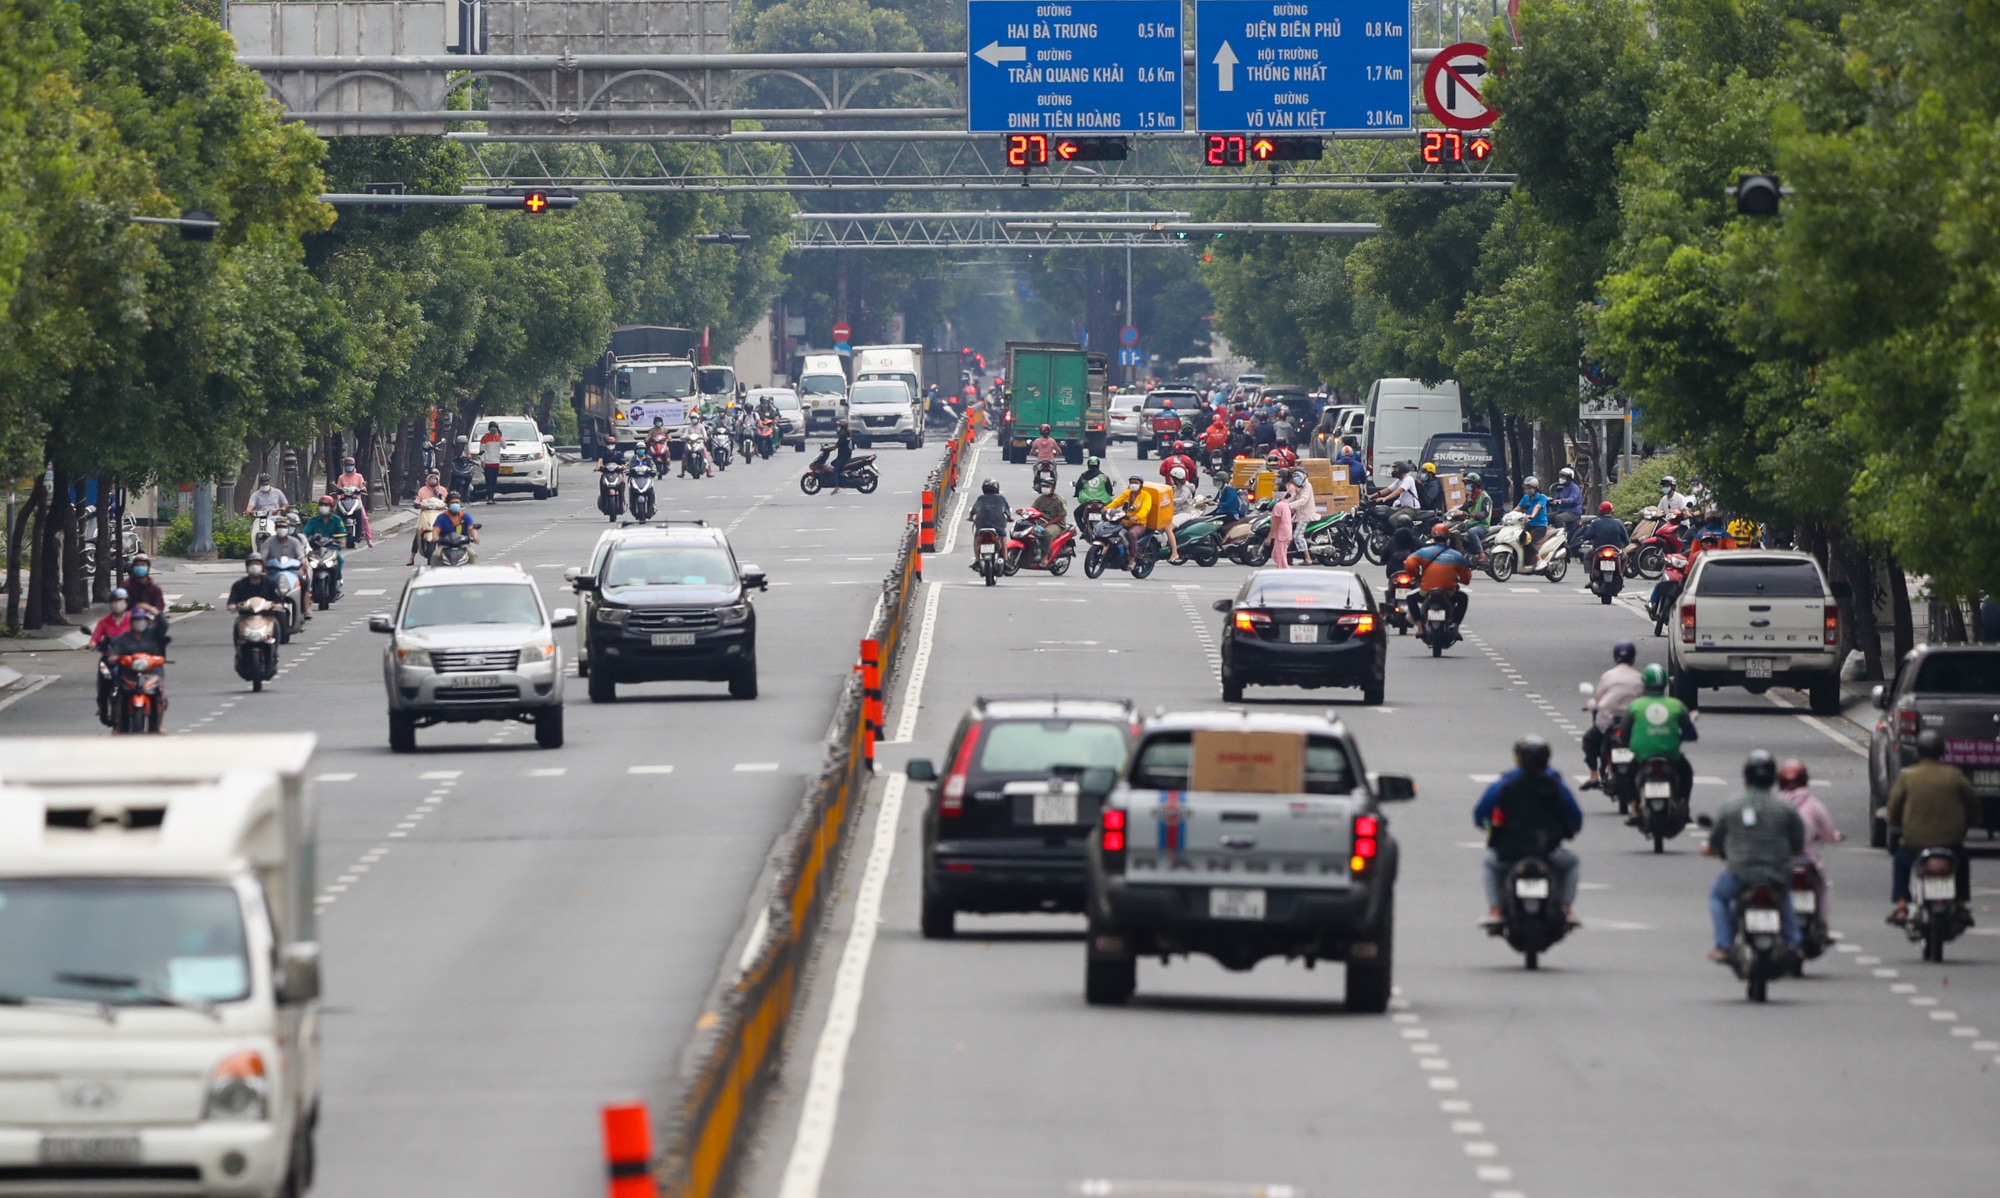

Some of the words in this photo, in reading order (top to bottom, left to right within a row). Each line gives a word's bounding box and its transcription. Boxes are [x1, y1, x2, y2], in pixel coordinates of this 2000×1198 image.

[1037, 3, 1072, 17] ĐƯỜNG
[1273, 2, 1308, 16] ĐƯỜNG
[1007, 23, 1029, 39] HAI
[1033, 20, 1051, 39] BÀ
[1054, 22, 1098, 39] TRƯNG
[1138, 23, 1154, 39] 0,5
[1157, 23, 1175, 38] Km
[1245, 20, 1276, 41] ĐIỆN
[1280, 19, 1311, 38] BIÊN
[1315, 18, 1341, 38] PHỦ
[1365, 22, 1381, 38] 0,8
[1385, 22, 1403, 37] Km
[1037, 47, 1072, 61] ĐƯỜNG
[1257, 47, 1275, 61] HỘI
[1277, 46, 1319, 60] TRƯỜNG
[1008, 62, 1042, 83] TRẦN
[1045, 68, 1089, 83] QUANG
[1093, 63, 1124, 83] KHẢI
[1138, 68, 1154, 83] 0,6
[1157, 68, 1175, 82] Km
[1246, 61, 1290, 82] THỐNG
[1294, 61, 1327, 81] NHẤT
[1366, 66, 1382, 82] 1,7
[1385, 66, 1403, 80] Km
[1037, 92, 1072, 106] ĐƯỜNG
[1274, 91, 1309, 105] ĐƯỜNG
[1007, 112, 1039, 128] ĐINH
[1043, 109, 1073, 128] TIÊN
[1077, 109, 1121, 128] HOÀNG
[1138, 112, 1154, 128] 1,5
[1157, 112, 1175, 127] Km
[1246, 109, 1263, 127] VÕ
[1267, 109, 1293, 127] VĂN
[1297, 108, 1327, 129] KIỆT
[1366, 110, 1382, 127] 3,0
[1385, 110, 1403, 125] Km
[1009, 135, 1046, 165] 27
[1208, 136, 1245, 165] 27
[1423, 132, 1461, 162] 27
[1701, 633, 1819, 641] RANGER
